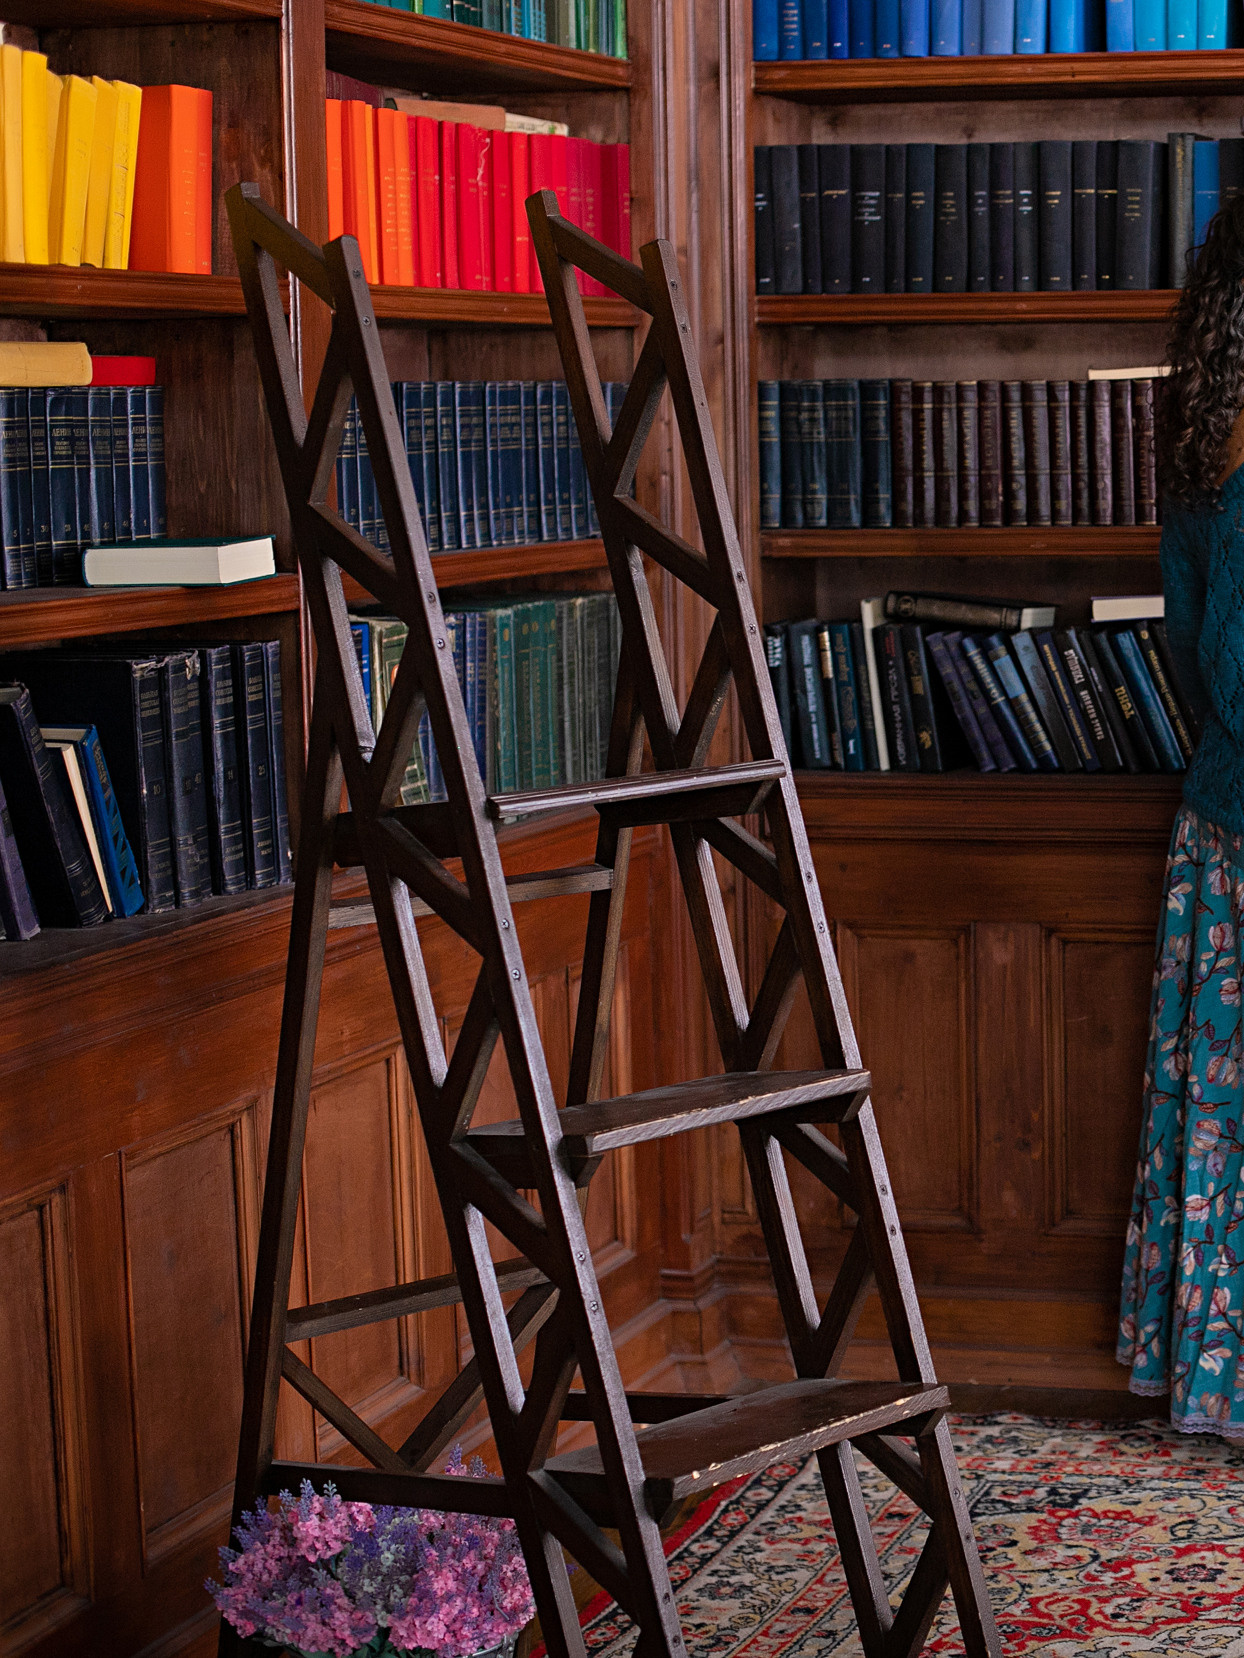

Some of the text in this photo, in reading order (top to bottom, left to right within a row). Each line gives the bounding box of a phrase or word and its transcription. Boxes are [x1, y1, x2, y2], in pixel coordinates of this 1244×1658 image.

[52, 427, 72, 437] ЛЕНИН
[92, 427, 111, 437] ЛЕНИН
[132, 425, 147, 434] ЛЕНИН
[1063, 648, 1086, 684] ГУЛЯЩАЯ
[888, 668, 899, 702] ПРОЗА
[893, 704, 907, 765] ИЗБРАННАЯ
[258, 764, 265, 776] 25
[153, 784, 161, 796] 10
